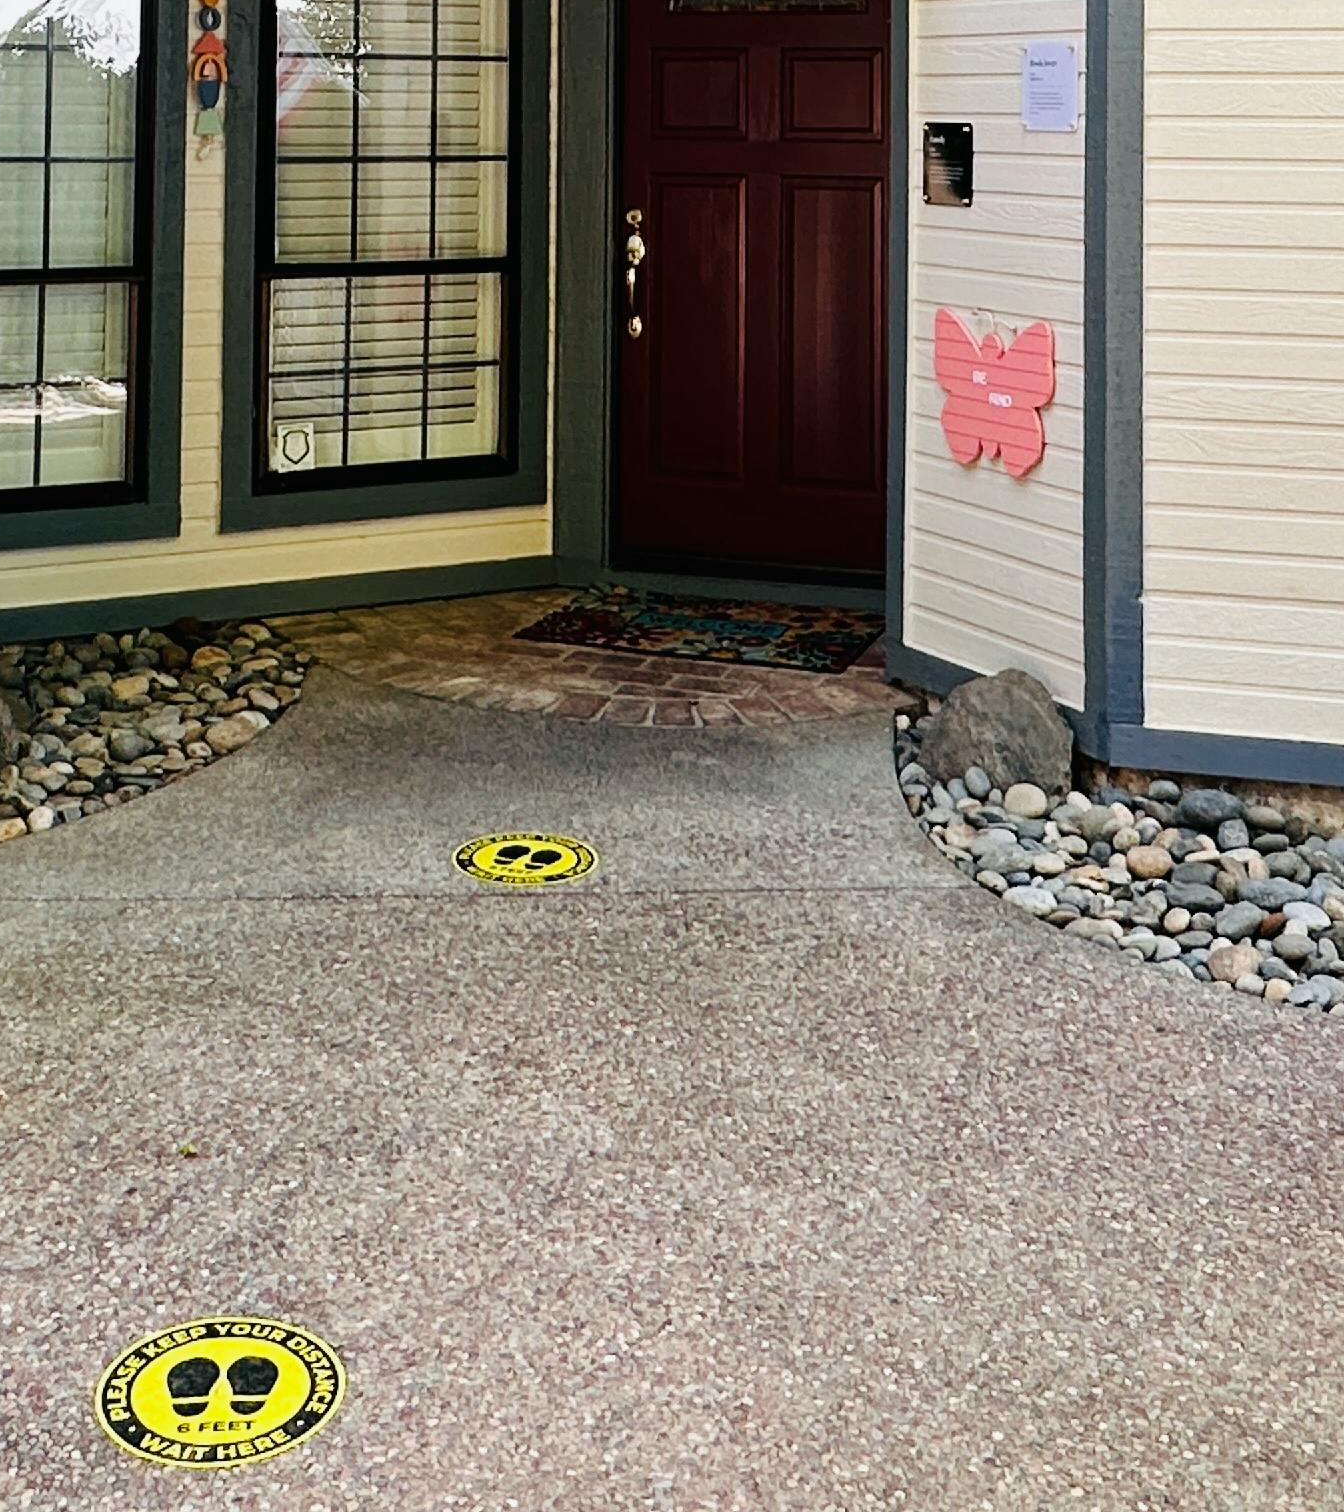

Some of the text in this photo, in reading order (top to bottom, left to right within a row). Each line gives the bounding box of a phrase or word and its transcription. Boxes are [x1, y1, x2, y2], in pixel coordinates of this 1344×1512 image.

[106, 1322, 335, 1423] PLEASE KEEP YOUR DISTANCE
[177, 1420, 256, 1433] 6 FEET
[139, 1429, 292, 1461] WAIT HERE
